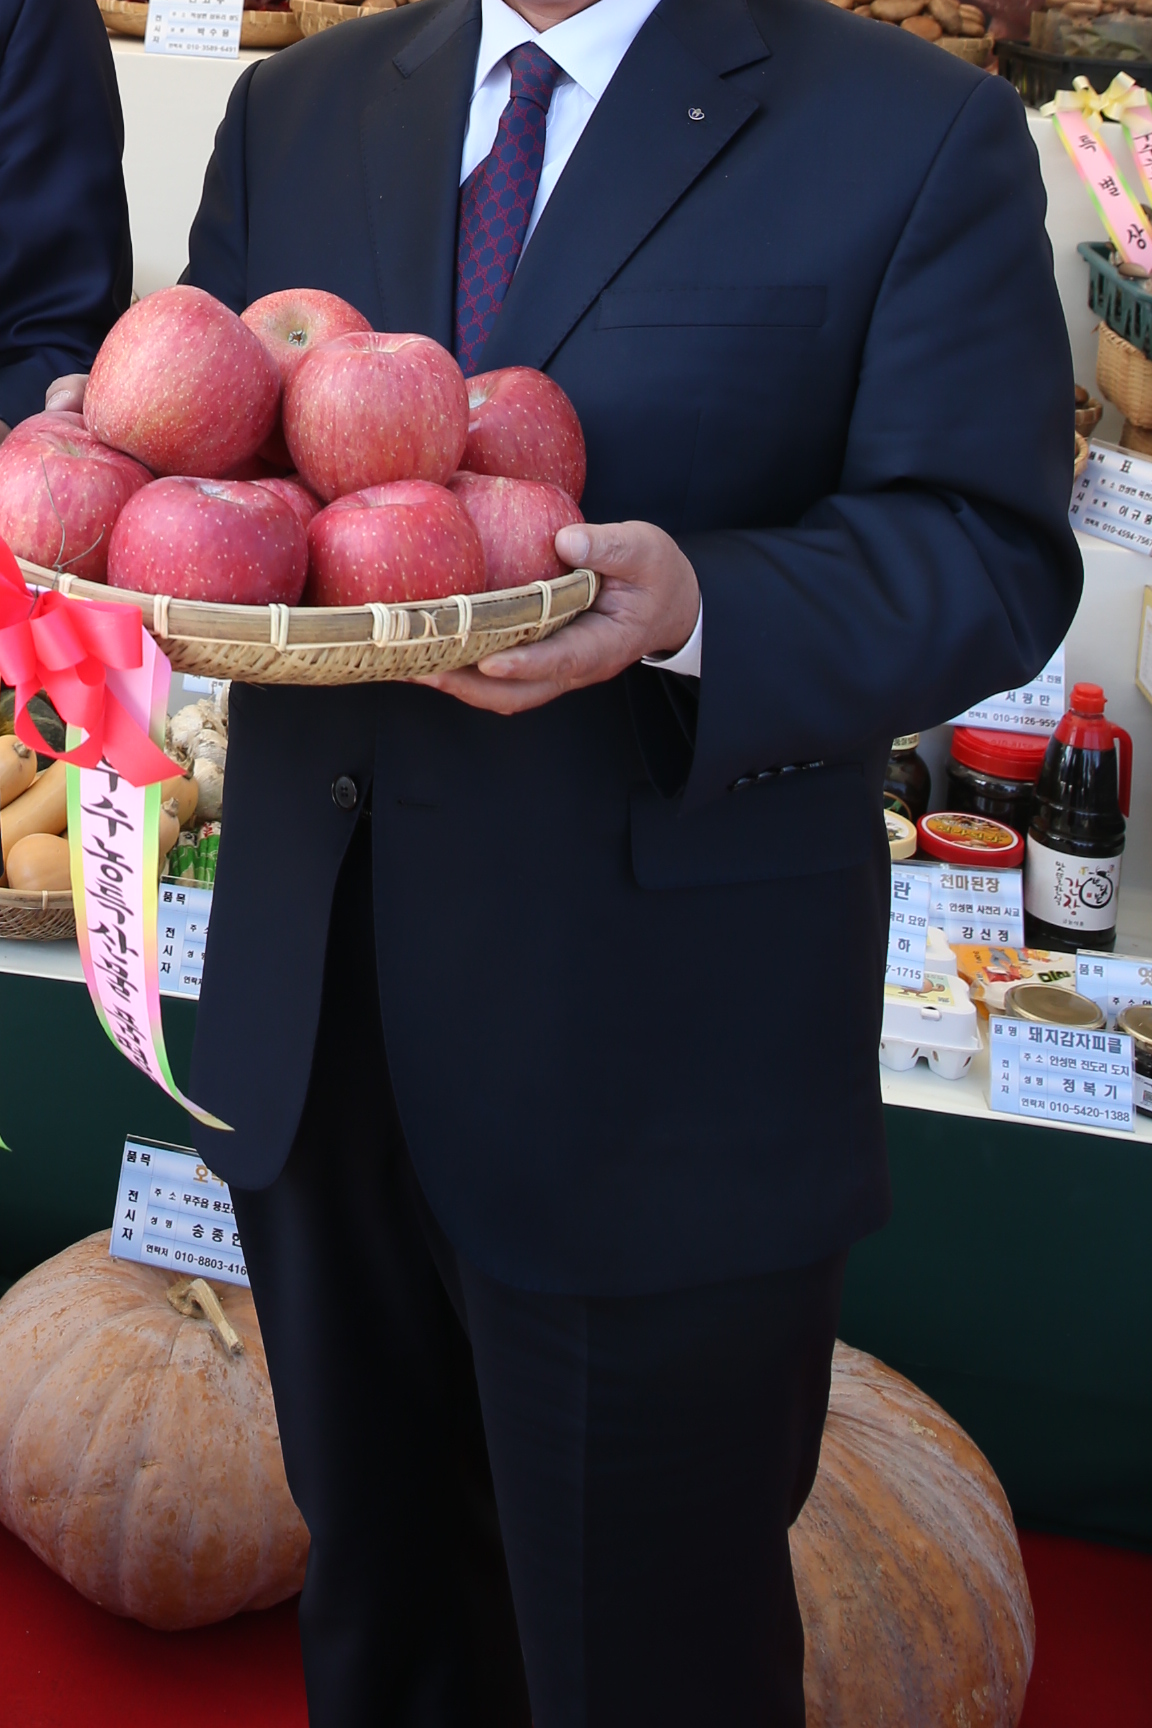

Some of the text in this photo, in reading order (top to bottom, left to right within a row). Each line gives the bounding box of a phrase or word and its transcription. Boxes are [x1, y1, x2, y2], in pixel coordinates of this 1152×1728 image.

[1120, 460, 1133, 474] 표
[163, 890, 186, 906] 품목
[949, 902, 974, 914] 안성면
[962, 926, 1009, 943] 강신정
[160, 926, 176, 974] 전시자
[1079, 963, 1105, 978] 품목
[993, 1023, 1123, 1055] 품명 돼지감자피클
[1023, 1051, 1130, 1078] 주소 안성면 진도리 도지
[1001, 1058, 1010, 1095] 전시자
[1023, 1075, 1118, 1100] 성명 정복기
[1049, 1101, 1130, 1123] 010-5420-1388
[126, 1149, 152, 1166] 품목
[154, 1187, 177, 1201] 주소
[182, 1193, 210, 1209] 무주읍
[121, 1189, 139, 1241] 전시자
[150, 1216, 173, 1229] 성명
